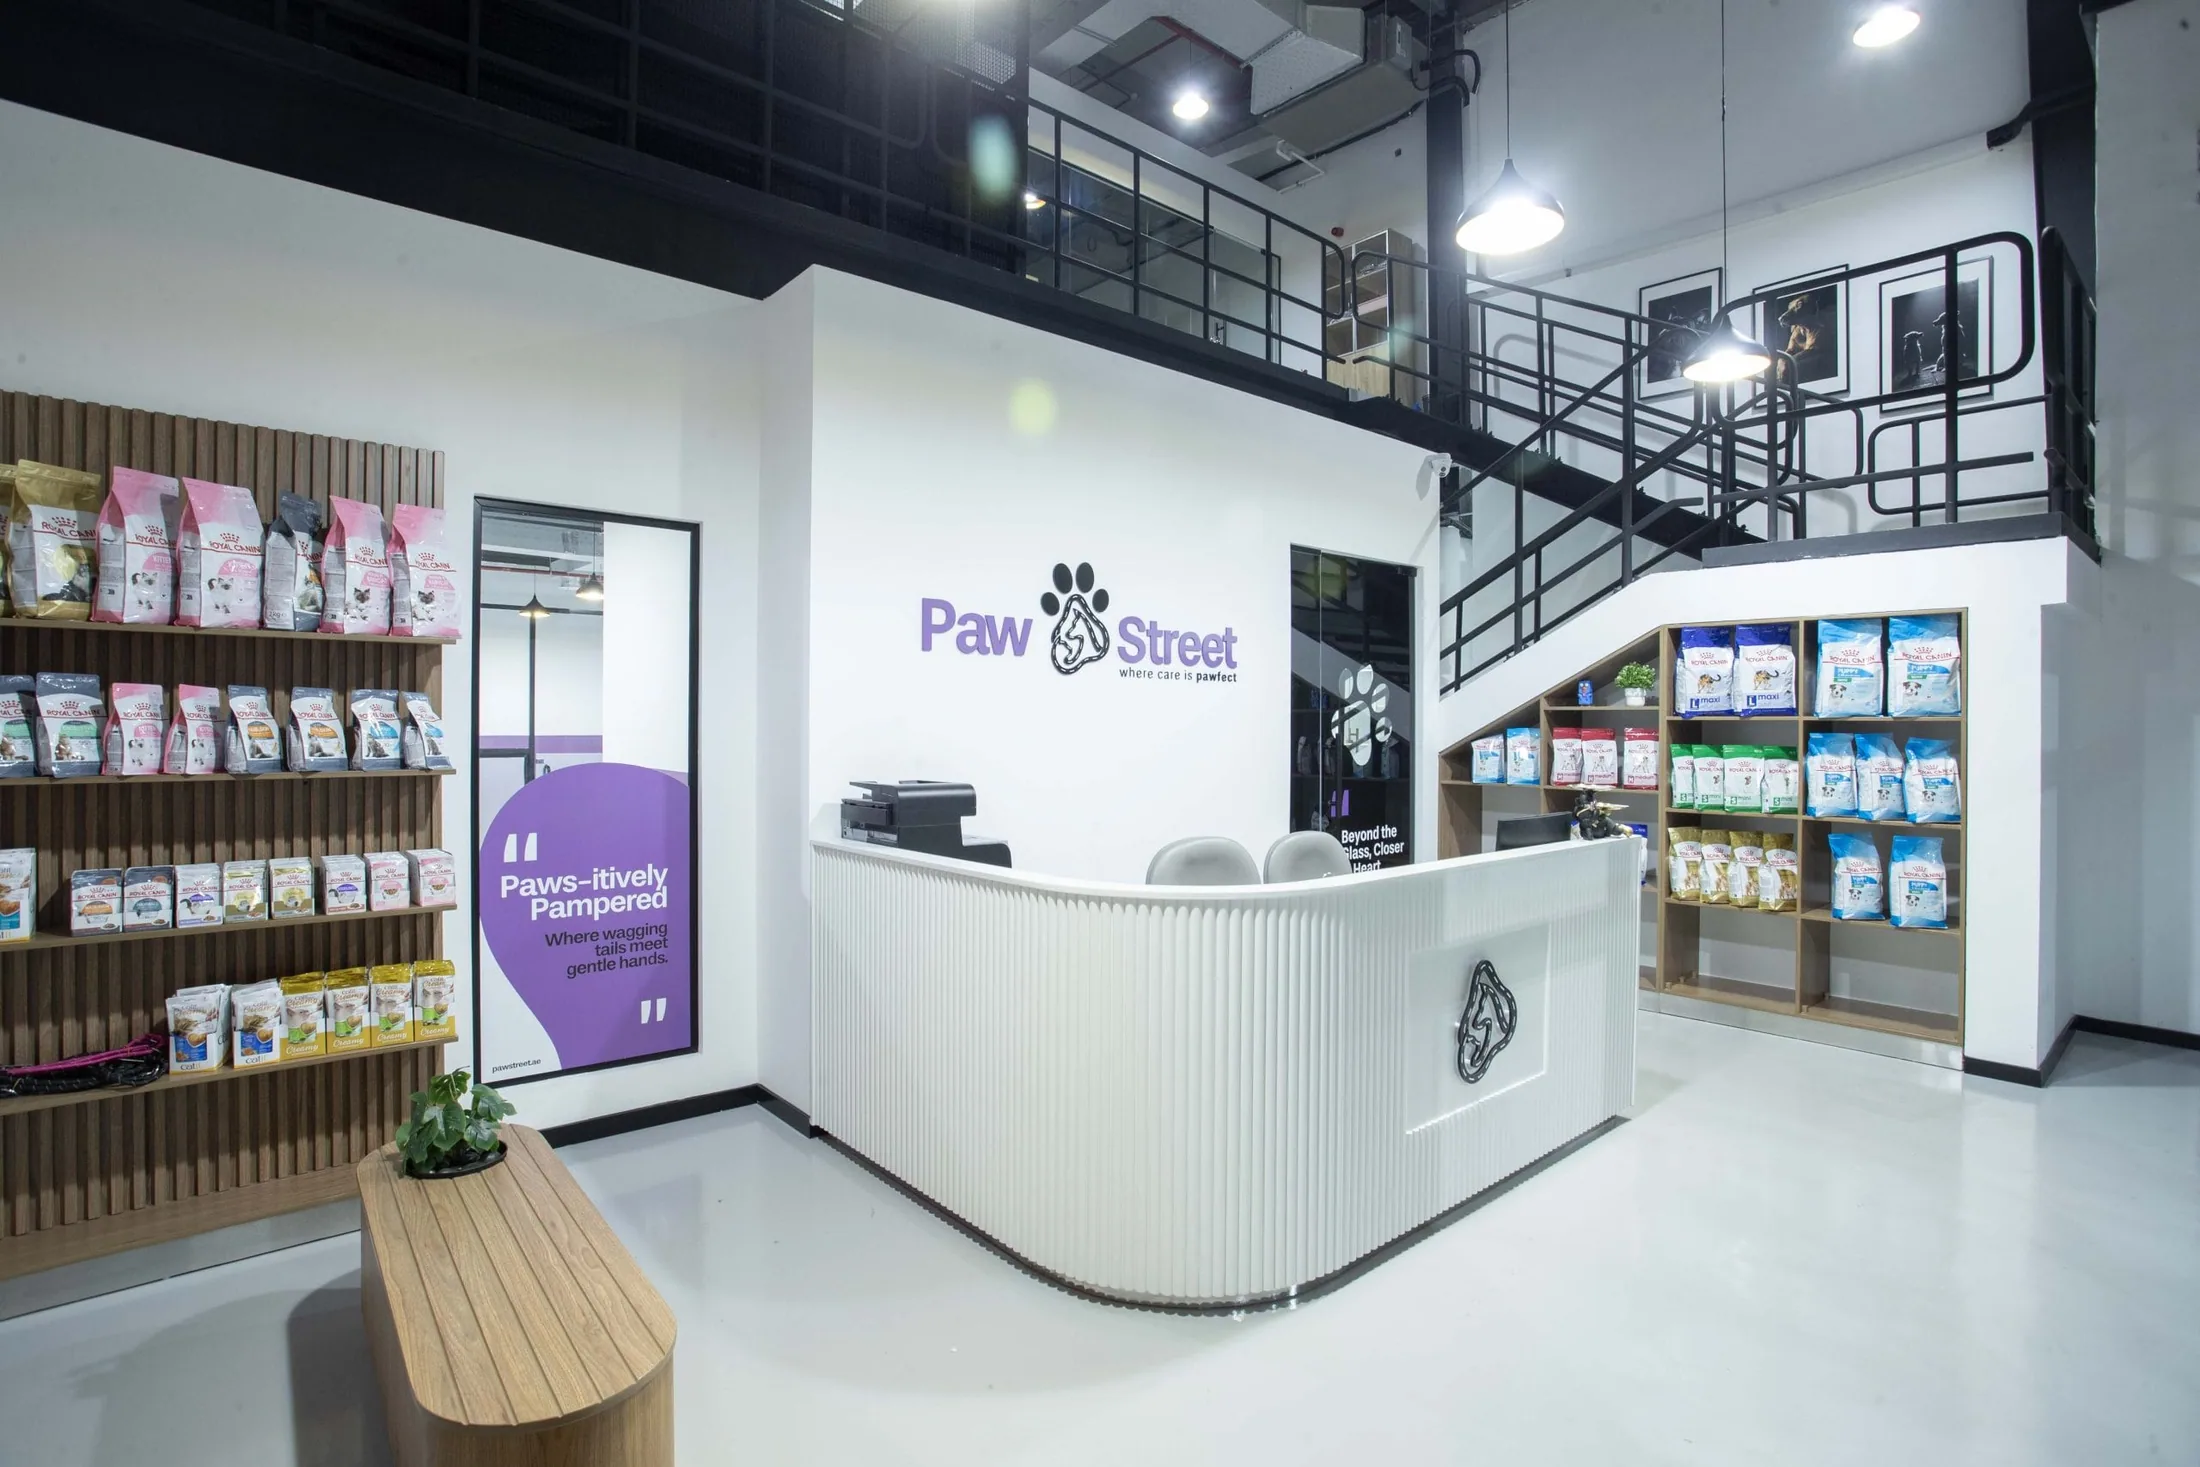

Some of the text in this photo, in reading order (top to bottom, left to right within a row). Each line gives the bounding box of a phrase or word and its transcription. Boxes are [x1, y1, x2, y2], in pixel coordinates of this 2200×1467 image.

[69, 529, 97, 537] CANI
[921, 597, 1238, 669] Paw Street
[1119, 667, 1238, 683] where care is pawfect
[1758, 693, 1780, 701] maxi
[46, 709, 70, 717] ROYAL
[1341, 824, 1397, 846] Beyond the
[1374, 841, 1405, 856] Closer
[1353, 860, 1381, 874] Heart
[501, 863, 669, 898] Paws-itively
[531, 886, 668, 921] Pampered
[545, 923, 668, 947] Where wagging
[595, 937, 669, 957] tails meet
[566, 952, 669, 980] gentle hands.
[377, 1032, 408, 1042] Creamy
[421, 1027, 450, 1037] Creamy
[286, 1045, 319, 1054] Creamy
[333, 1038, 364, 1048] Creamy
[492, 1059, 541, 1074] pawstreet.ae
